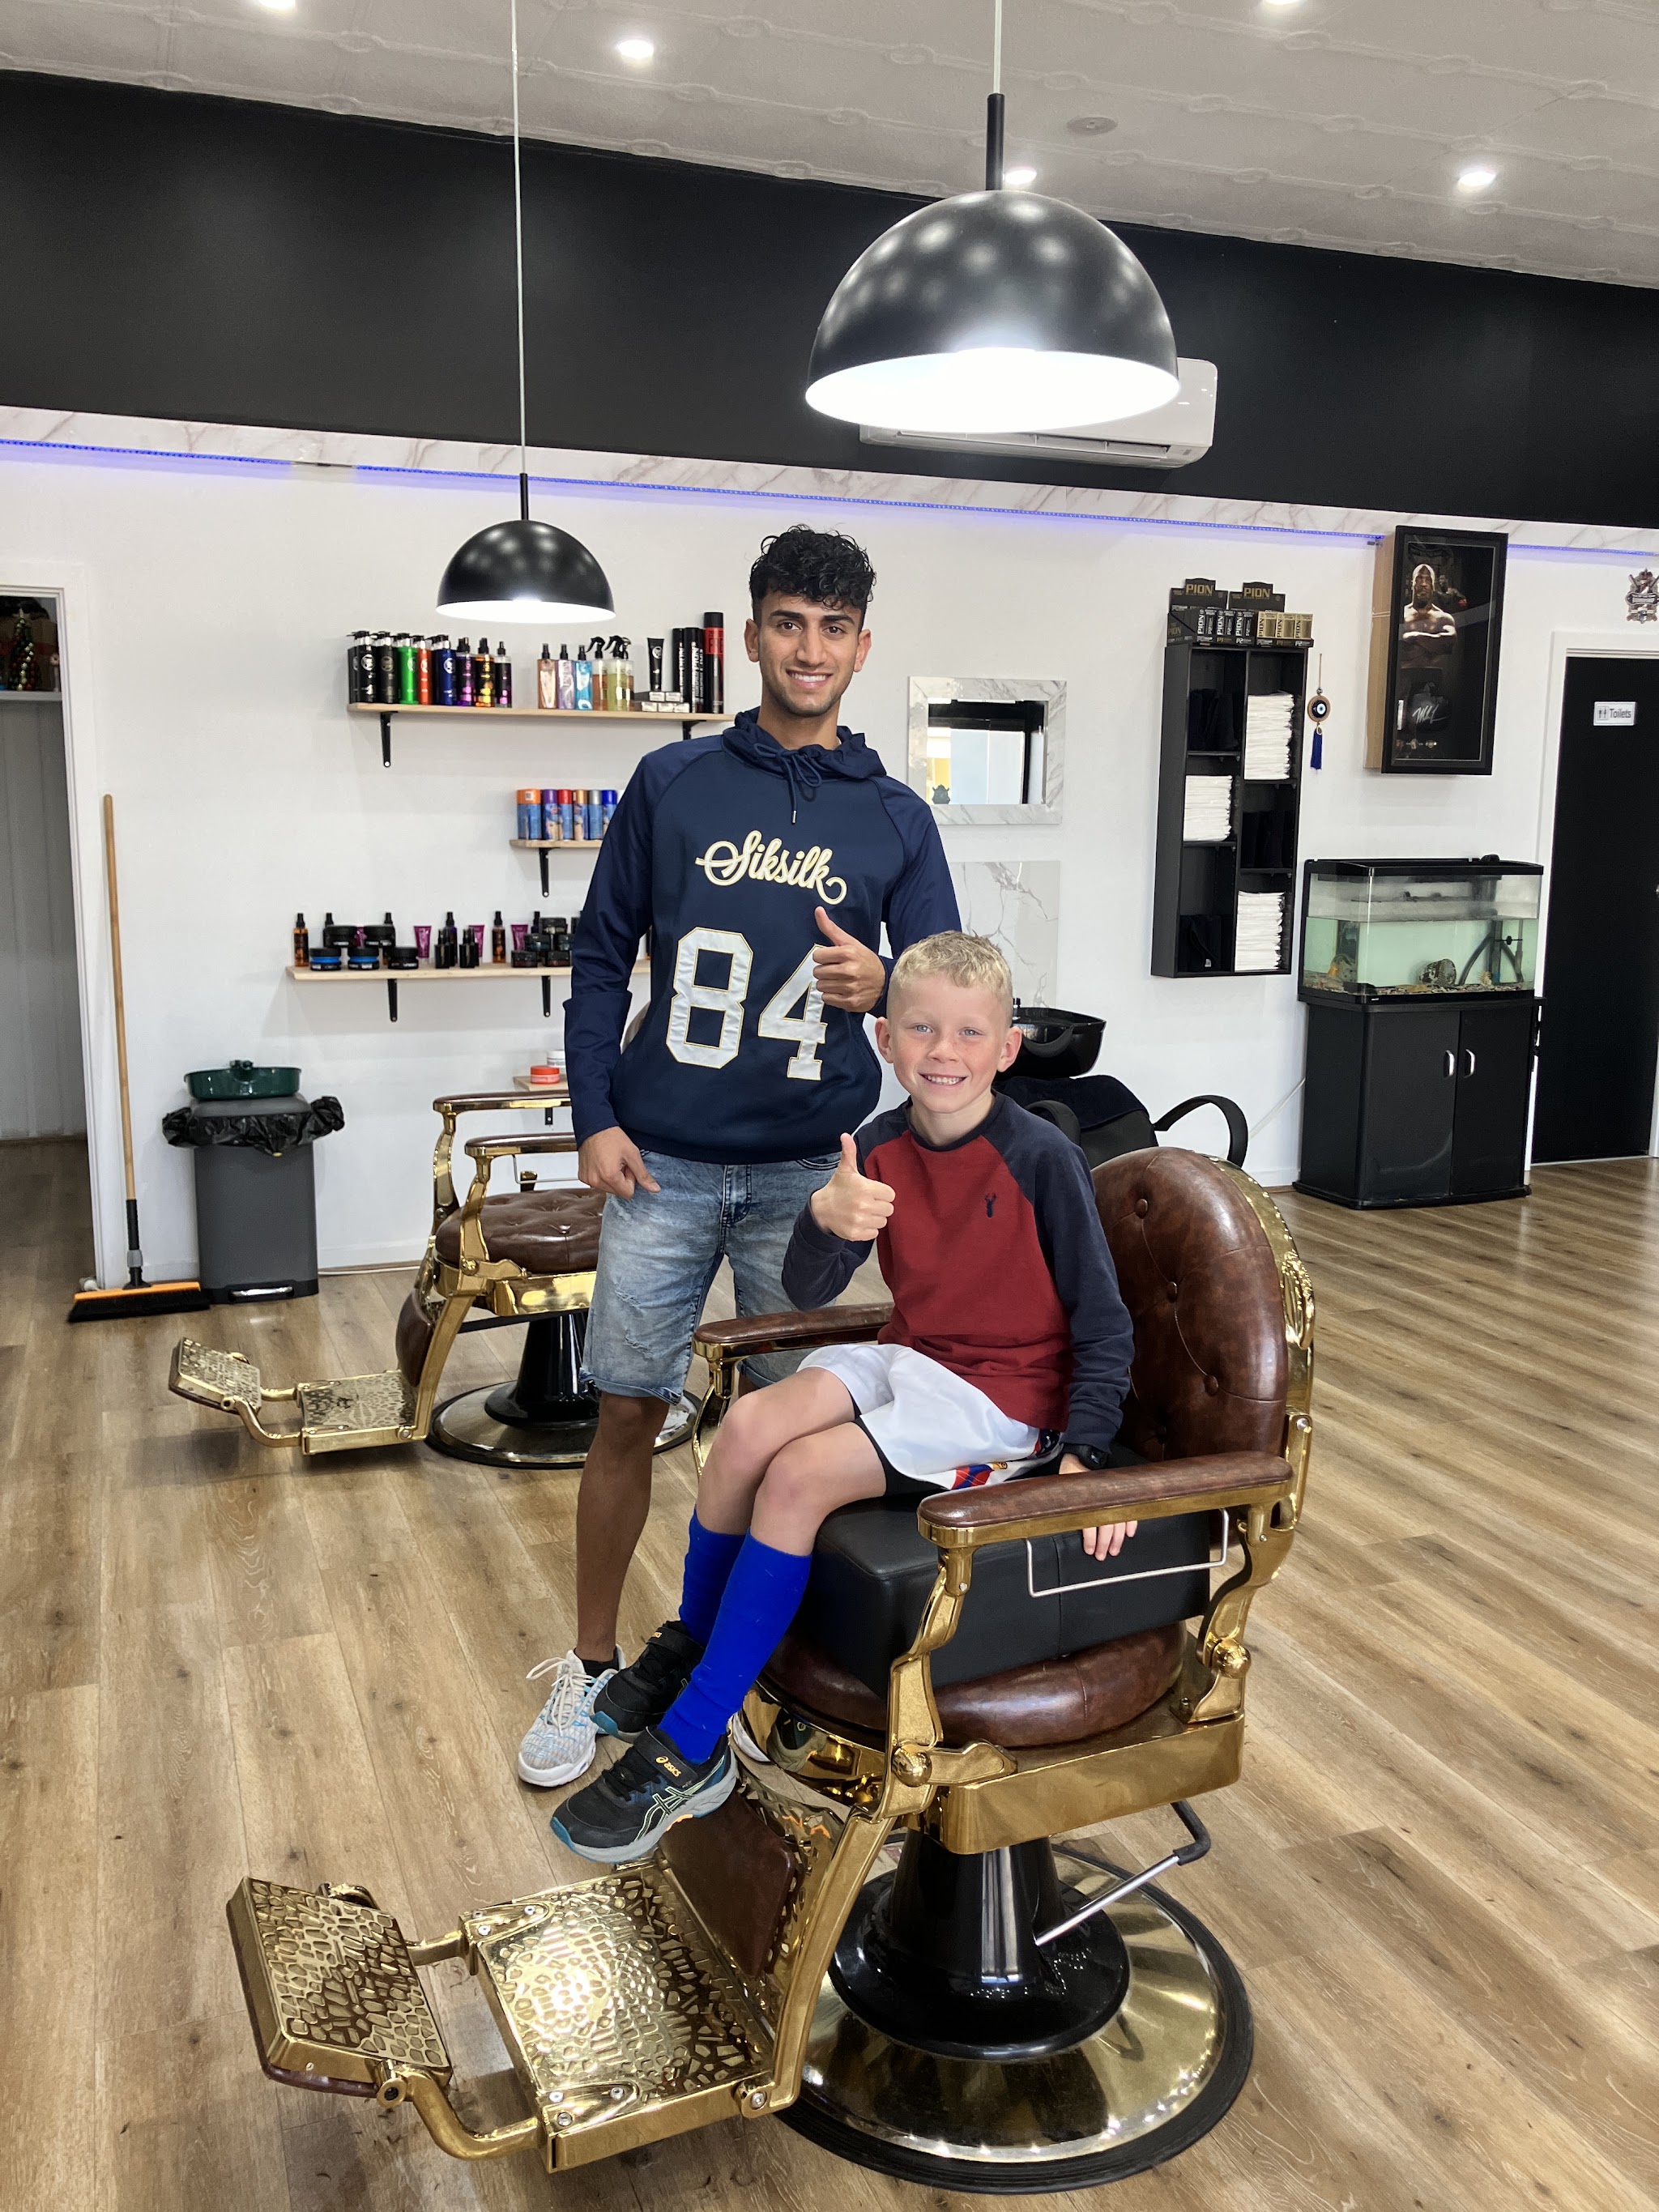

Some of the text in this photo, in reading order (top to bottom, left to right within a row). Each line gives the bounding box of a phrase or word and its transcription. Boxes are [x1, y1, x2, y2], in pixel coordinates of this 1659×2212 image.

[1185, 584, 1213, 595] PION
[1243, 587, 1270, 598] PION
[1197, 615, 1205, 635] PION
[1217, 616, 1225, 636] PION
[1235, 617, 1243, 637] PION
[1610, 708, 1631, 718] Toilets
[665, 926, 829, 1081] 84
